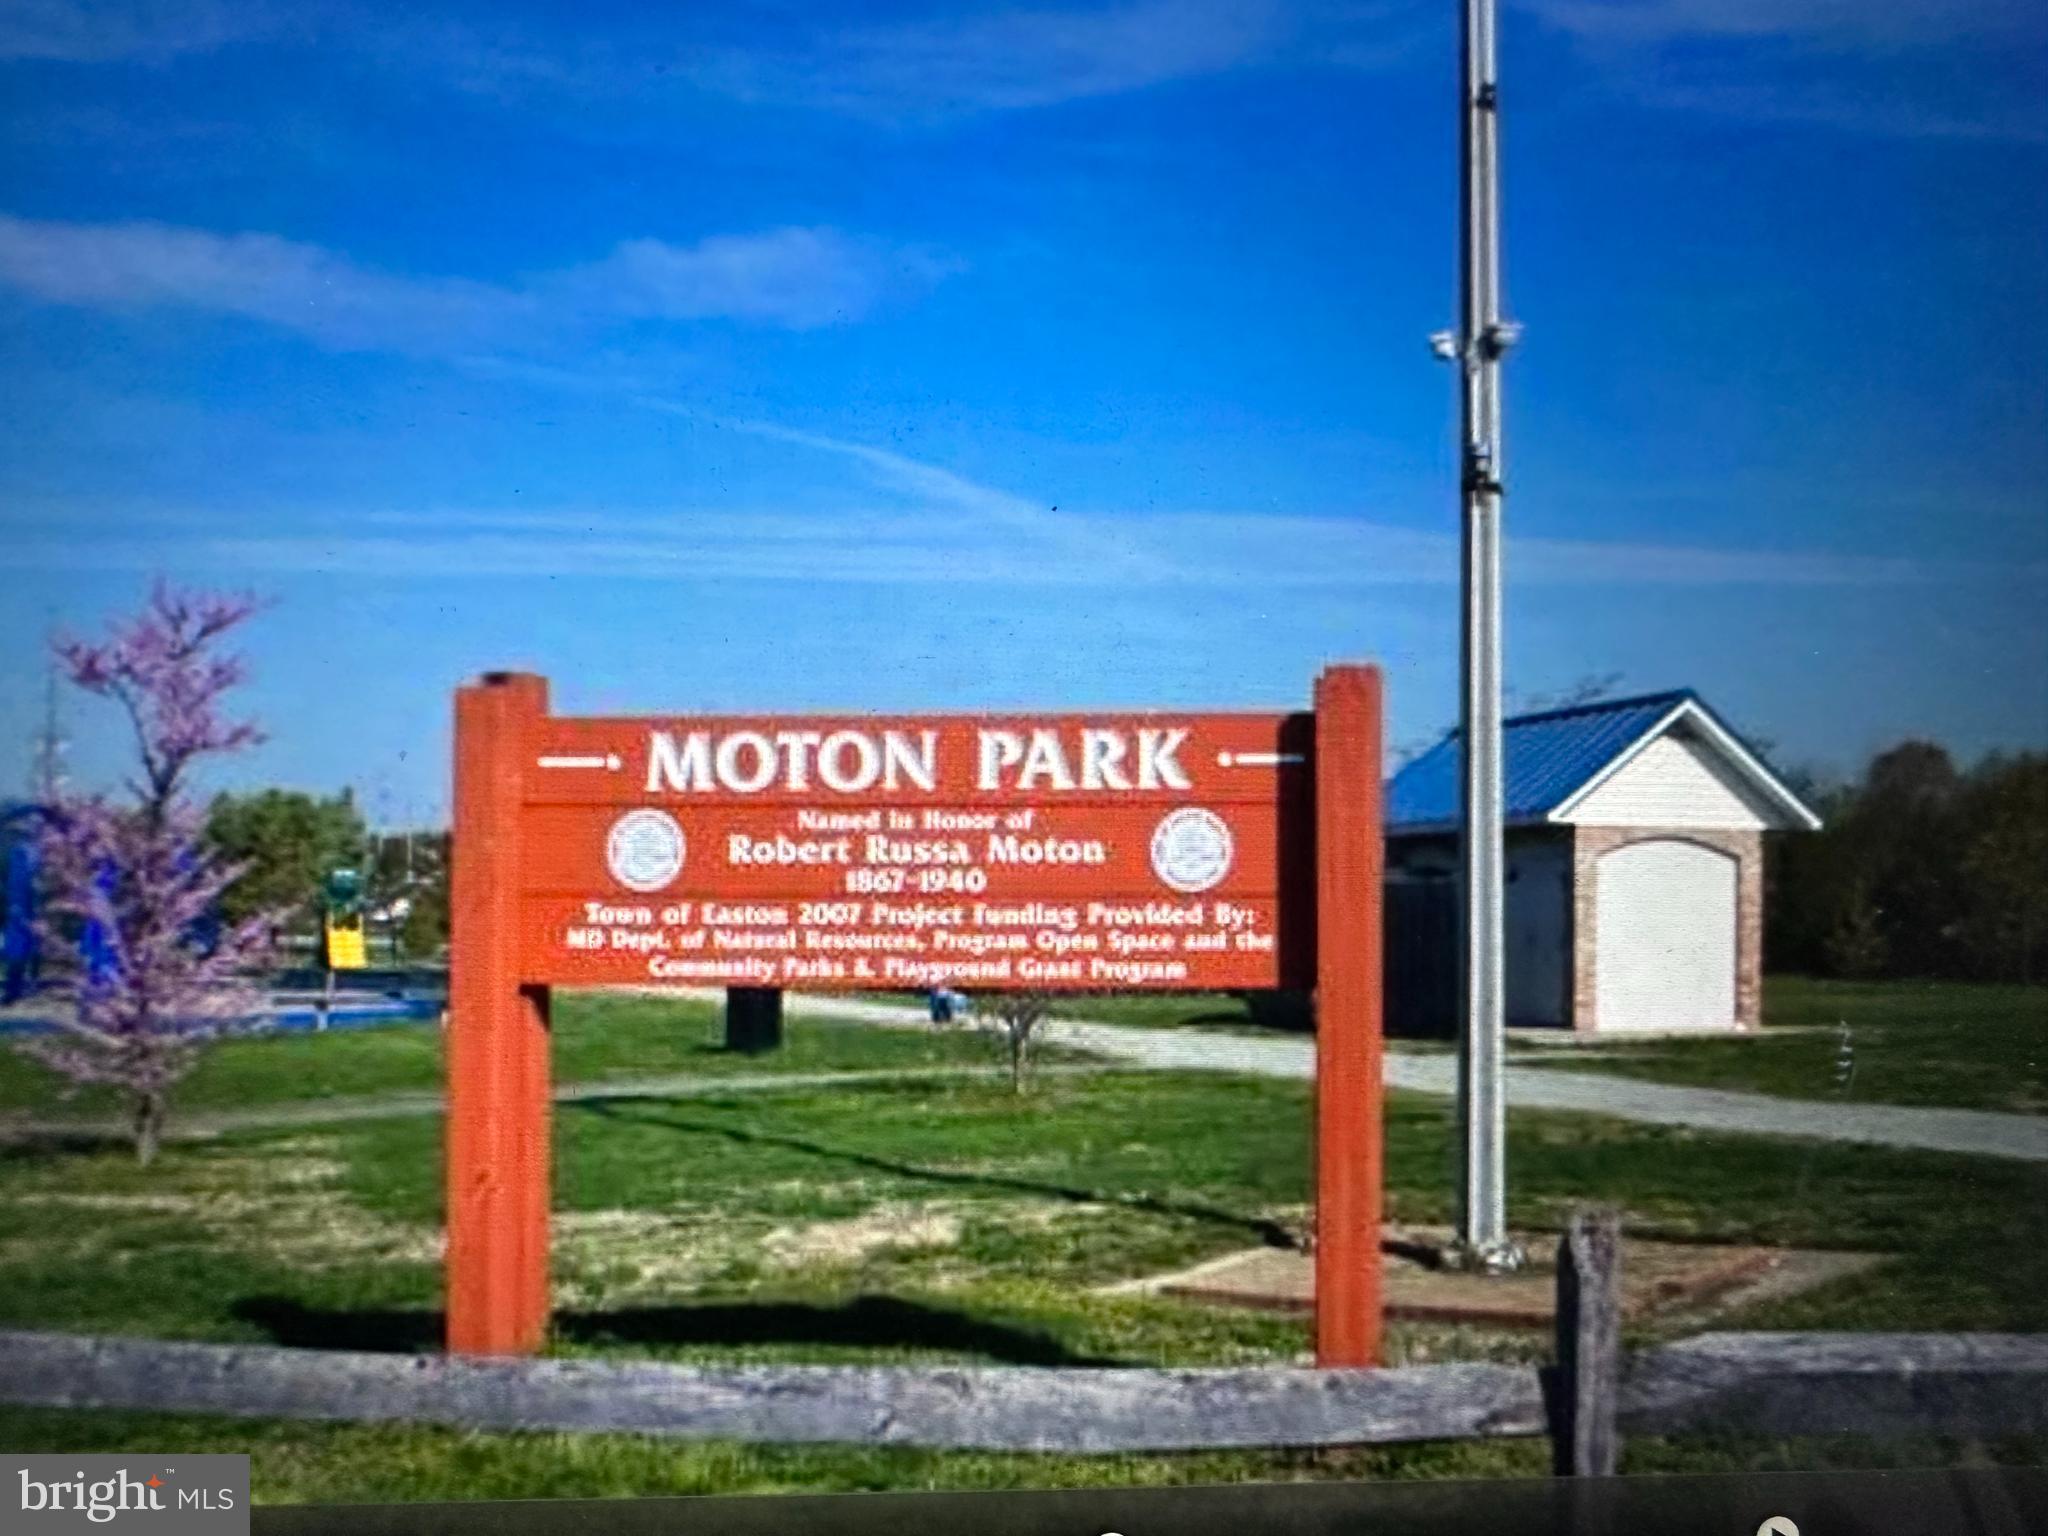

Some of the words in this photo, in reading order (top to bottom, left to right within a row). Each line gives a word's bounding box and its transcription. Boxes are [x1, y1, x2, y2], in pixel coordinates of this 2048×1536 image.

[645, 730, 938, 793] MOTON
[977, 727, 1193, 791] PARK
[797, 810, 881, 830] Named
[923, 810, 999, 830] Honor
[1004, 809, 1034, 830] of
[728, 833, 850, 864] Robert
[865, 834, 970, 864] Russa
[988, 834, 1106, 864] Moton
[584, 902, 652, 925] Town
[661, 903, 692, 925] of
[702, 903, 789, 925] Easton
[798, 902, 862, 925] 2007
[872, 902, 964, 931] Project
[973, 902, 1078, 931] Funding
[1087, 902, 1204, 926] Provided
[1214, 902, 1255, 931] By:
[611, 928, 671, 954] Dept.
[680, 929, 706, 949] of
[713, 928, 797, 949] Natural
[933, 929, 1028, 955] Program
[1035, 929, 1099, 955] Open
[1106, 929, 1176, 955] Space
[1184, 930, 1227, 950] and
[1235, 930, 1274, 950] the
[648, 956, 776, 983] Community
[884, 957, 1012, 984] Playground
[1090, 957, 1188, 983] Program
